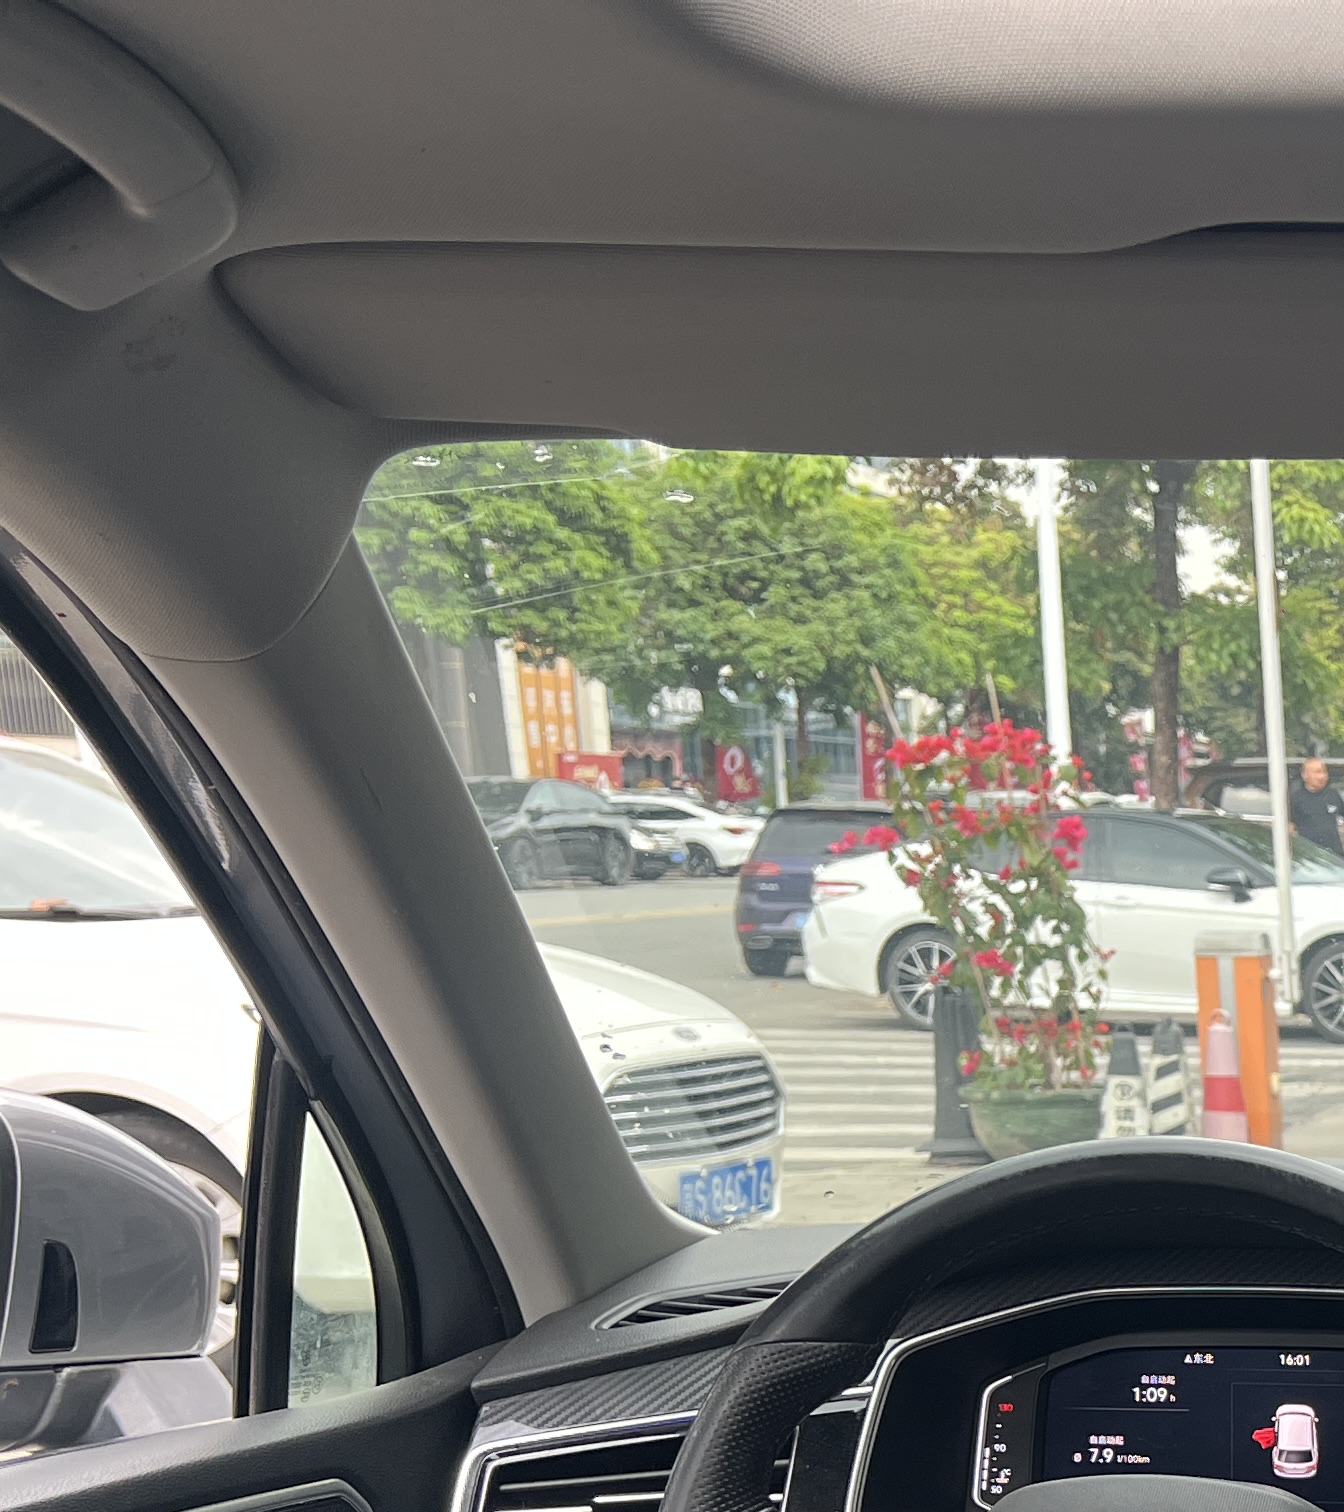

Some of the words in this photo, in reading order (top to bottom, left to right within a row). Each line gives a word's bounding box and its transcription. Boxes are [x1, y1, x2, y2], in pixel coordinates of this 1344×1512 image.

[1279, 1353, 1311, 1366] 16:01
[1131, 1386, 1168, 1403] 1:09
[993, 1443, 1007, 1453] 90
[1087, 1447, 1114, 1463] 7.9
